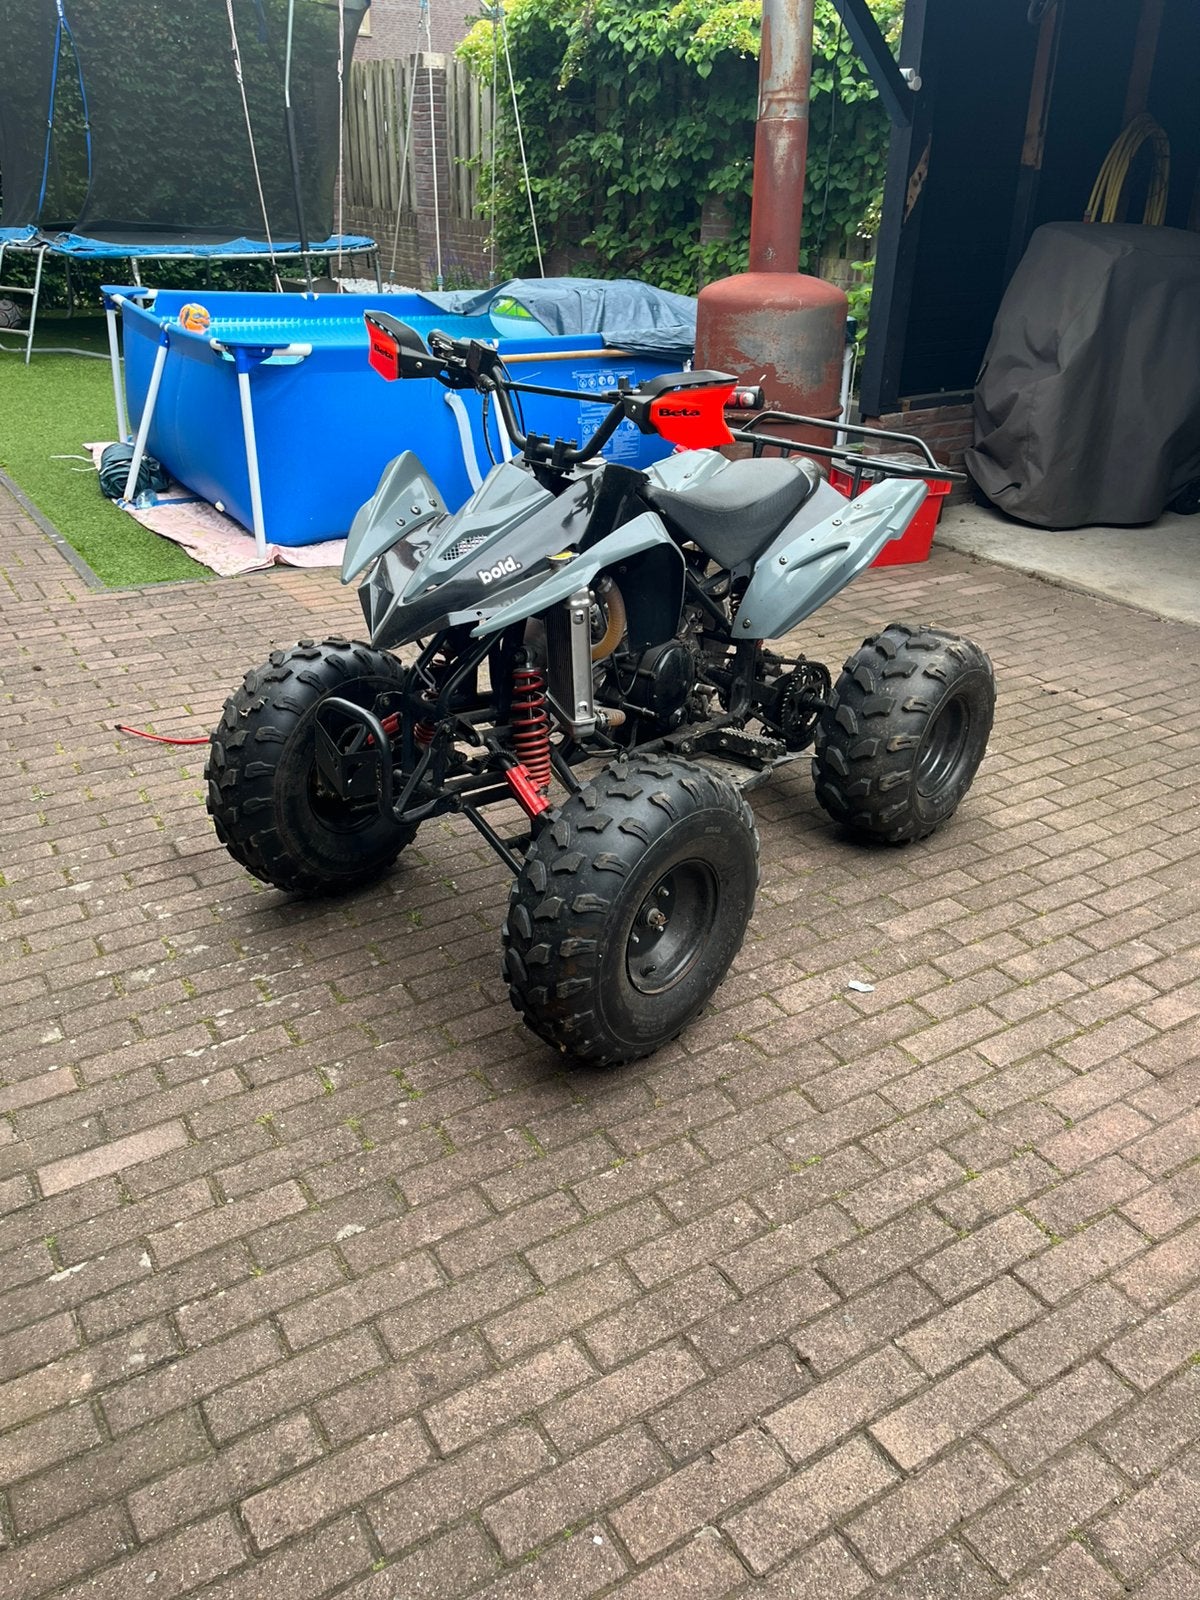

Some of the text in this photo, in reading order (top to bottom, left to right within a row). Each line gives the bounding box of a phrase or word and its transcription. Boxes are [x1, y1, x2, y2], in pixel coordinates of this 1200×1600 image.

[373, 343, 395, 361] Beta
[658, 407, 701, 417] Beta
[478, 556, 521, 584] bold.
